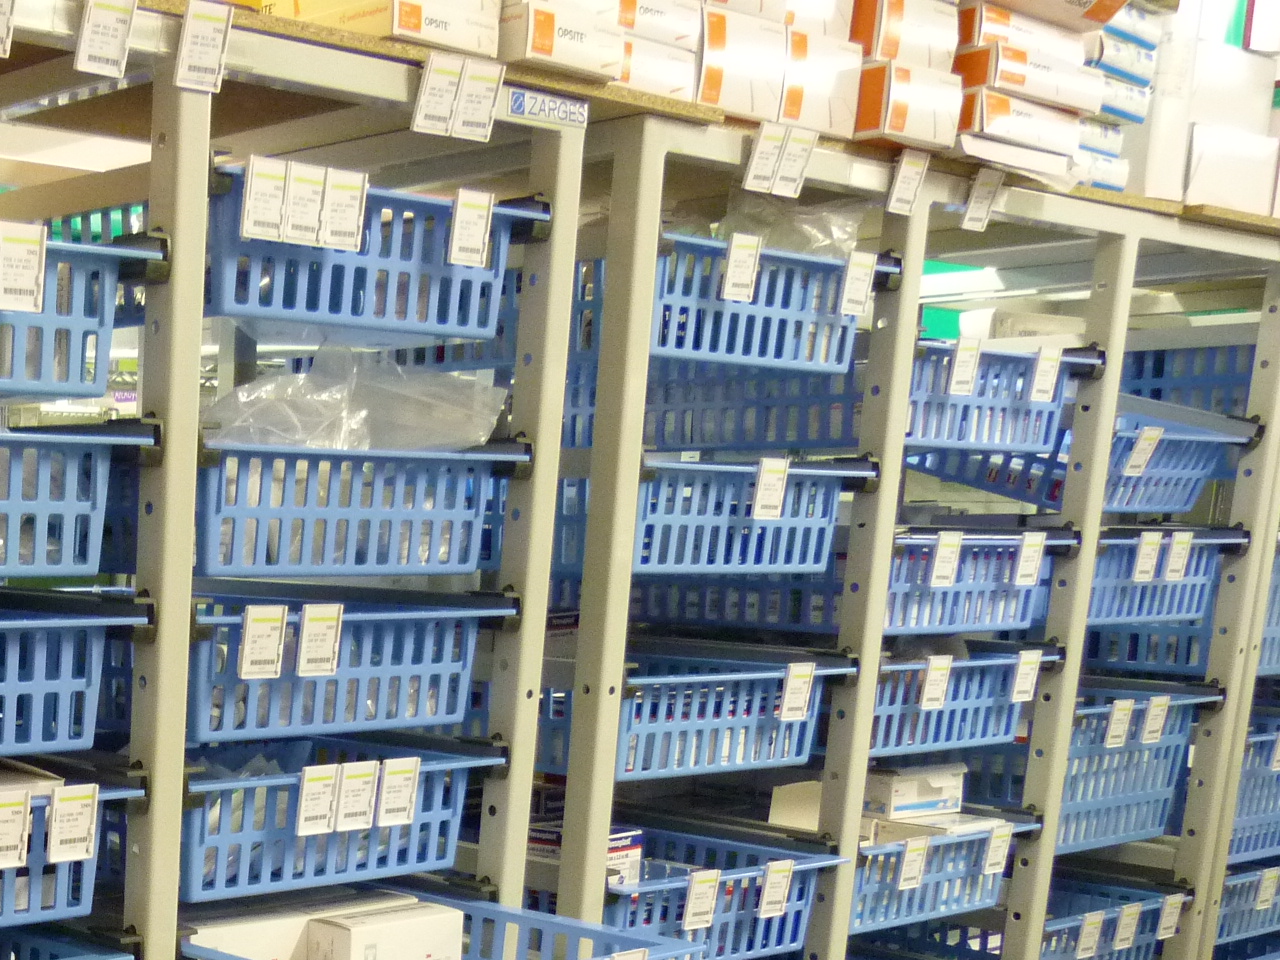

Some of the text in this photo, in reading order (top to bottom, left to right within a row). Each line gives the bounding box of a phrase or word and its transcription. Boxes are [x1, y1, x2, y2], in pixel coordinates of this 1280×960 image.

[424, 16, 448, 31] OPSITE
[557, 27, 585, 44] OPSITE
[528, 95, 586, 124] ZARGES
